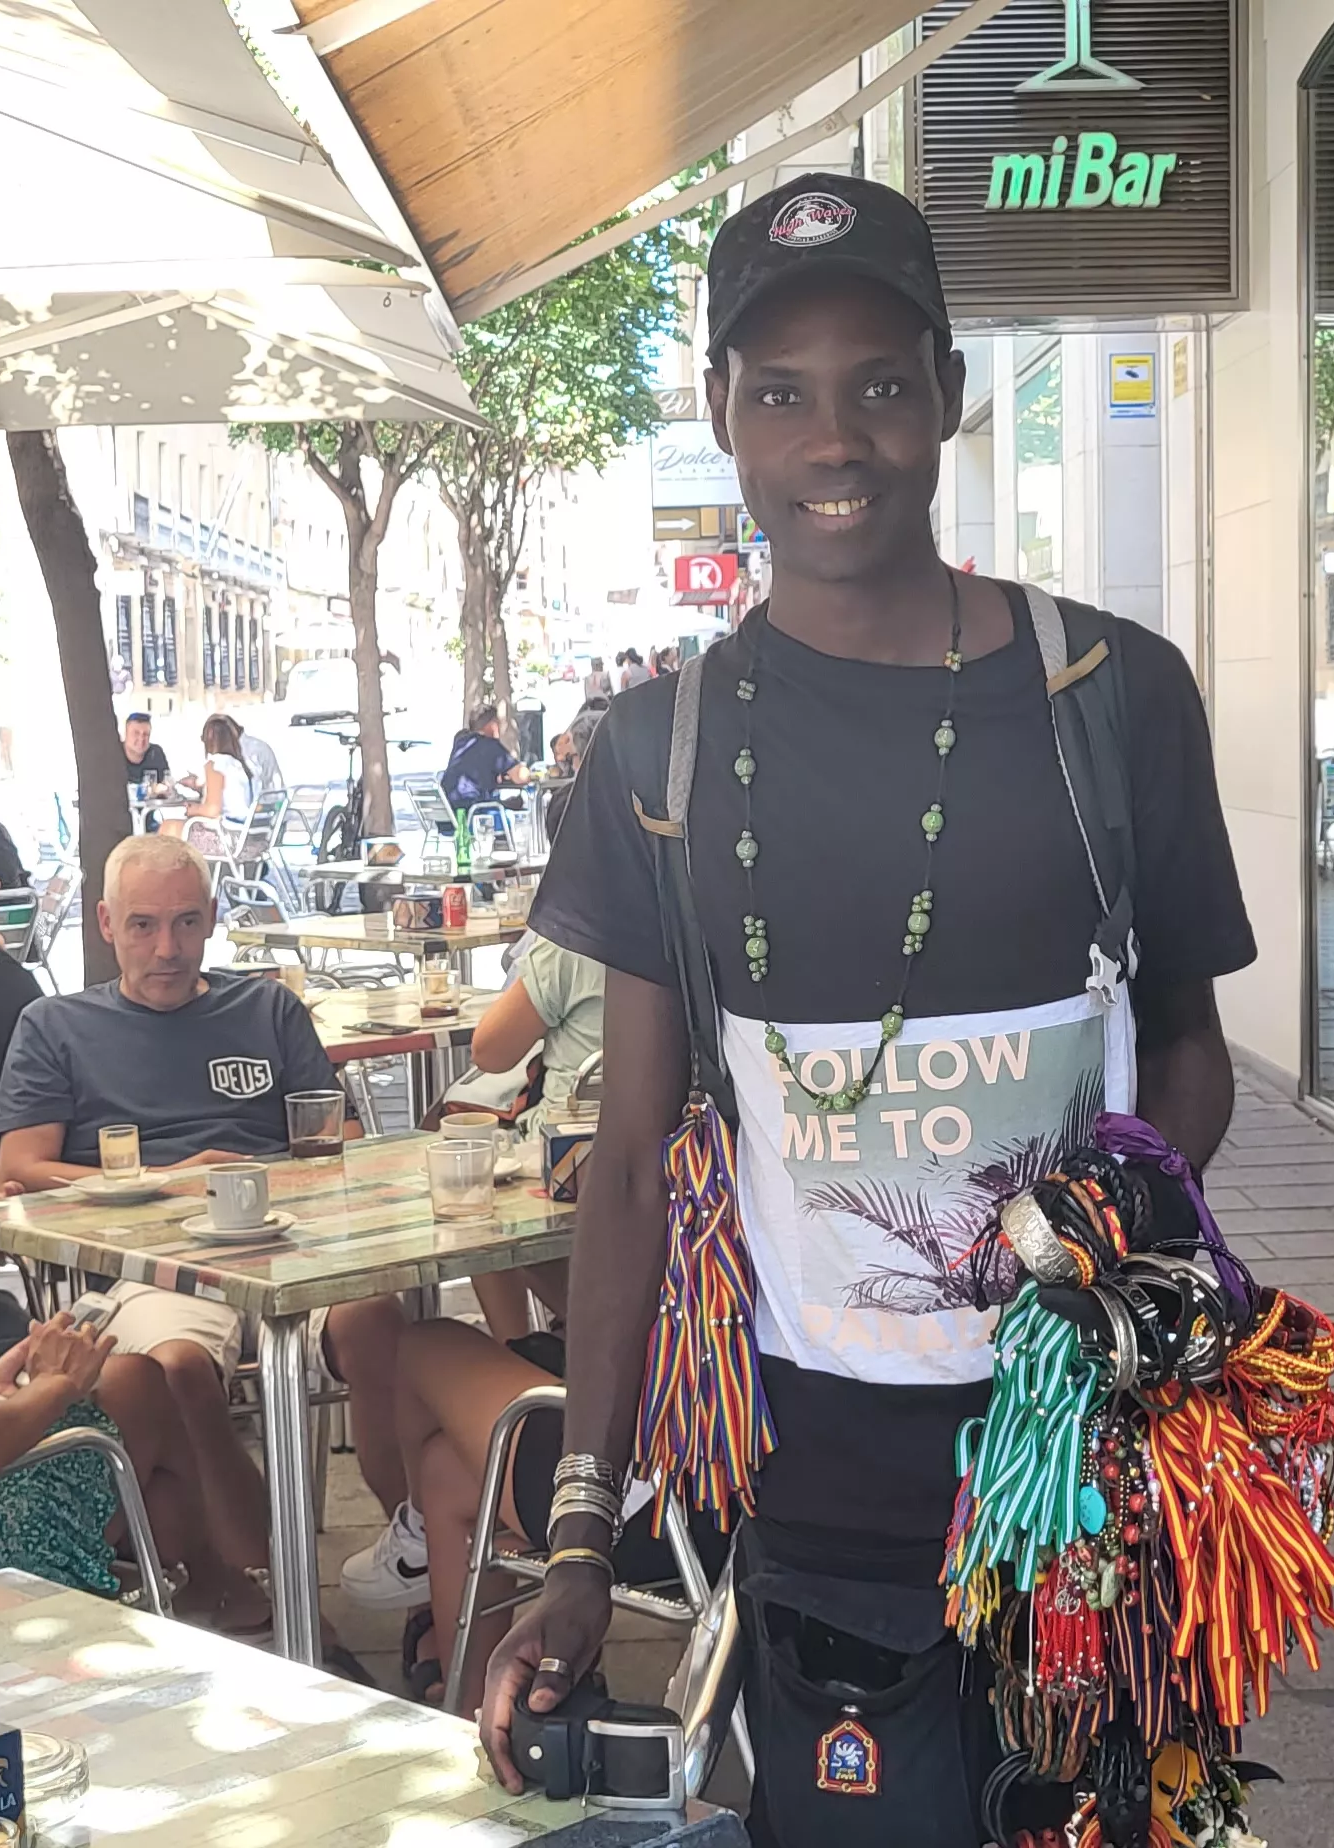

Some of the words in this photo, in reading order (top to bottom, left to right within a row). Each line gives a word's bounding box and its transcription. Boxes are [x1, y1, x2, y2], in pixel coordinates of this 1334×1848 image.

[773, 217, 805, 239] High
[808, 207, 852, 221] Waves
[772, 1031, 1031, 1097] FOLLOW
[782, 1113, 861, 1162] ME
[879, 1105, 973, 1159] TO
